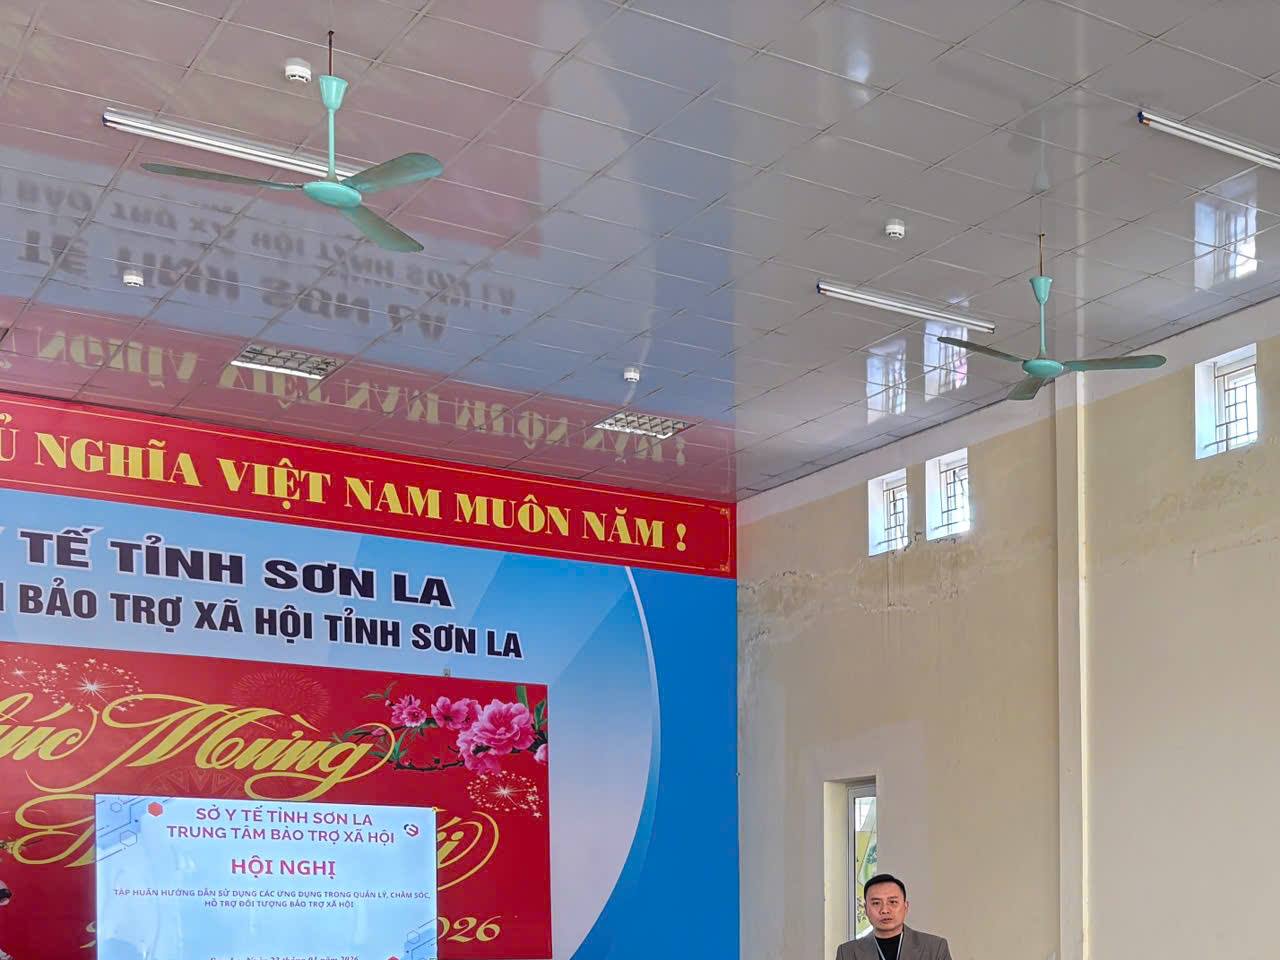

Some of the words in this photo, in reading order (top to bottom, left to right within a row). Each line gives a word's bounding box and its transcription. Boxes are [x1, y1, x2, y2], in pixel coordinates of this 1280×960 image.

[34, 431, 202, 487] NGHĨA
[216, 456, 331, 510] VIỆT
[344, 476, 442, 520] NAM
[454, 493, 571, 537] MUÔN
[581, 506, 665, 550] NĂM
[675, 522, 687, 552] !
[19, 526, 98, 569] TẾ
[109, 534, 244, 585] TỈNH
[263, 558, 375, 600] SƠN
[392, 573, 453, 608] LA
[18, 577, 98, 619] BẢO
[109, 592, 183, 633] TRỢ
[193, 598, 244, 633] XÃ
[254, 604, 313, 644] HỘI
[323, 607, 401, 648] TỈNH
[411, 623, 476, 652] SƠN
[486, 630, 523, 659] LA
[25, 692, 396, 802] Mừng
[195, 804, 221, 821] SỞ
[225, 808, 237, 822] Y
[241, 805, 264, 823] TẾ
[266, 806, 308, 824] TỈNH
[312, 811, 348, 826] SƠN
[352, 813, 373, 827] LA
[166, 825, 227, 839] TRUNG
[230, 826, 266, 840] TÂM
[270, 825, 304, 841] BẢO
[308, 829, 340, 845] TRỢ
[344, 829, 365, 843] XÃ
[368, 830, 395, 847] HỘI
[231, 855, 273, 879] HỘI
[279, 859, 337, 880] NGHỊ
[219, 899, 237, 909] TRỢ
[256, 899, 288, 909] TƯỢNG
[232, 890, 257, 899] DỤNG
[259, 889, 276, 898] CÁC
[298, 890, 322, 899] DỤNG
[324, 891, 352, 899] TRONG
